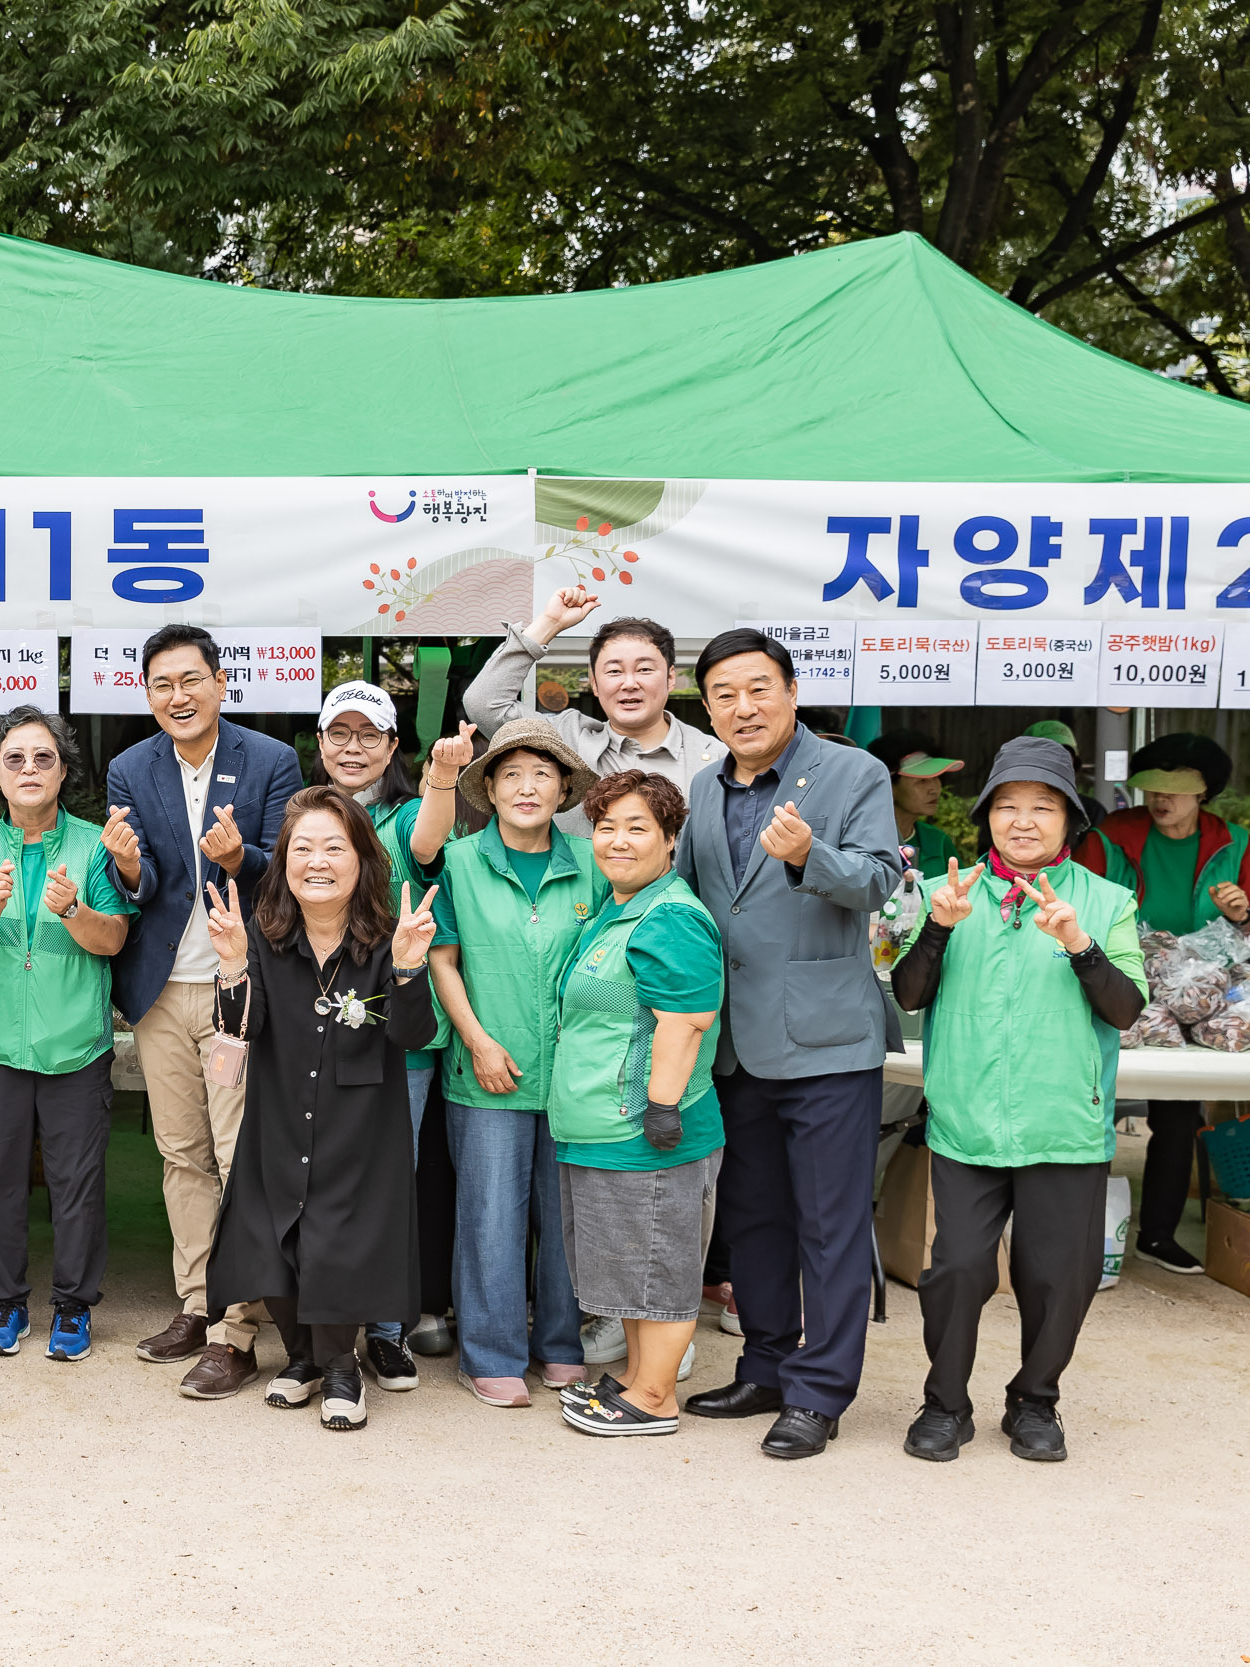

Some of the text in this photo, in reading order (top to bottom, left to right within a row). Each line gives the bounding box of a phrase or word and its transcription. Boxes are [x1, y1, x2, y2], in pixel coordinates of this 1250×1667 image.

[422, 489, 487, 502] 소통하며 발전하는
[422, 501, 487, 524] 행복광진
[860, 636, 971, 653] 도토리묵(국산)
[985, 636, 1093, 652] 도토리묵(중국산)
[1107, 634, 1216, 653] 공주햇밤(1kg)
[17, 648, 44, 664] 1kg
[122, 647, 137, 662] 덕
[787, 648, 852, 661] 마을부녀회)
[225, 667, 252, 683] 튀기
[275, 668, 315, 683] 5,000
[794, 667, 850, 678] 6-1742-8
[879, 663, 951, 682] 5,000원
[1002, 662, 1074, 680] 3,000원
[1113, 663, 1207, 684] 10,000원
[331, 688, 383, 706] Titleist
